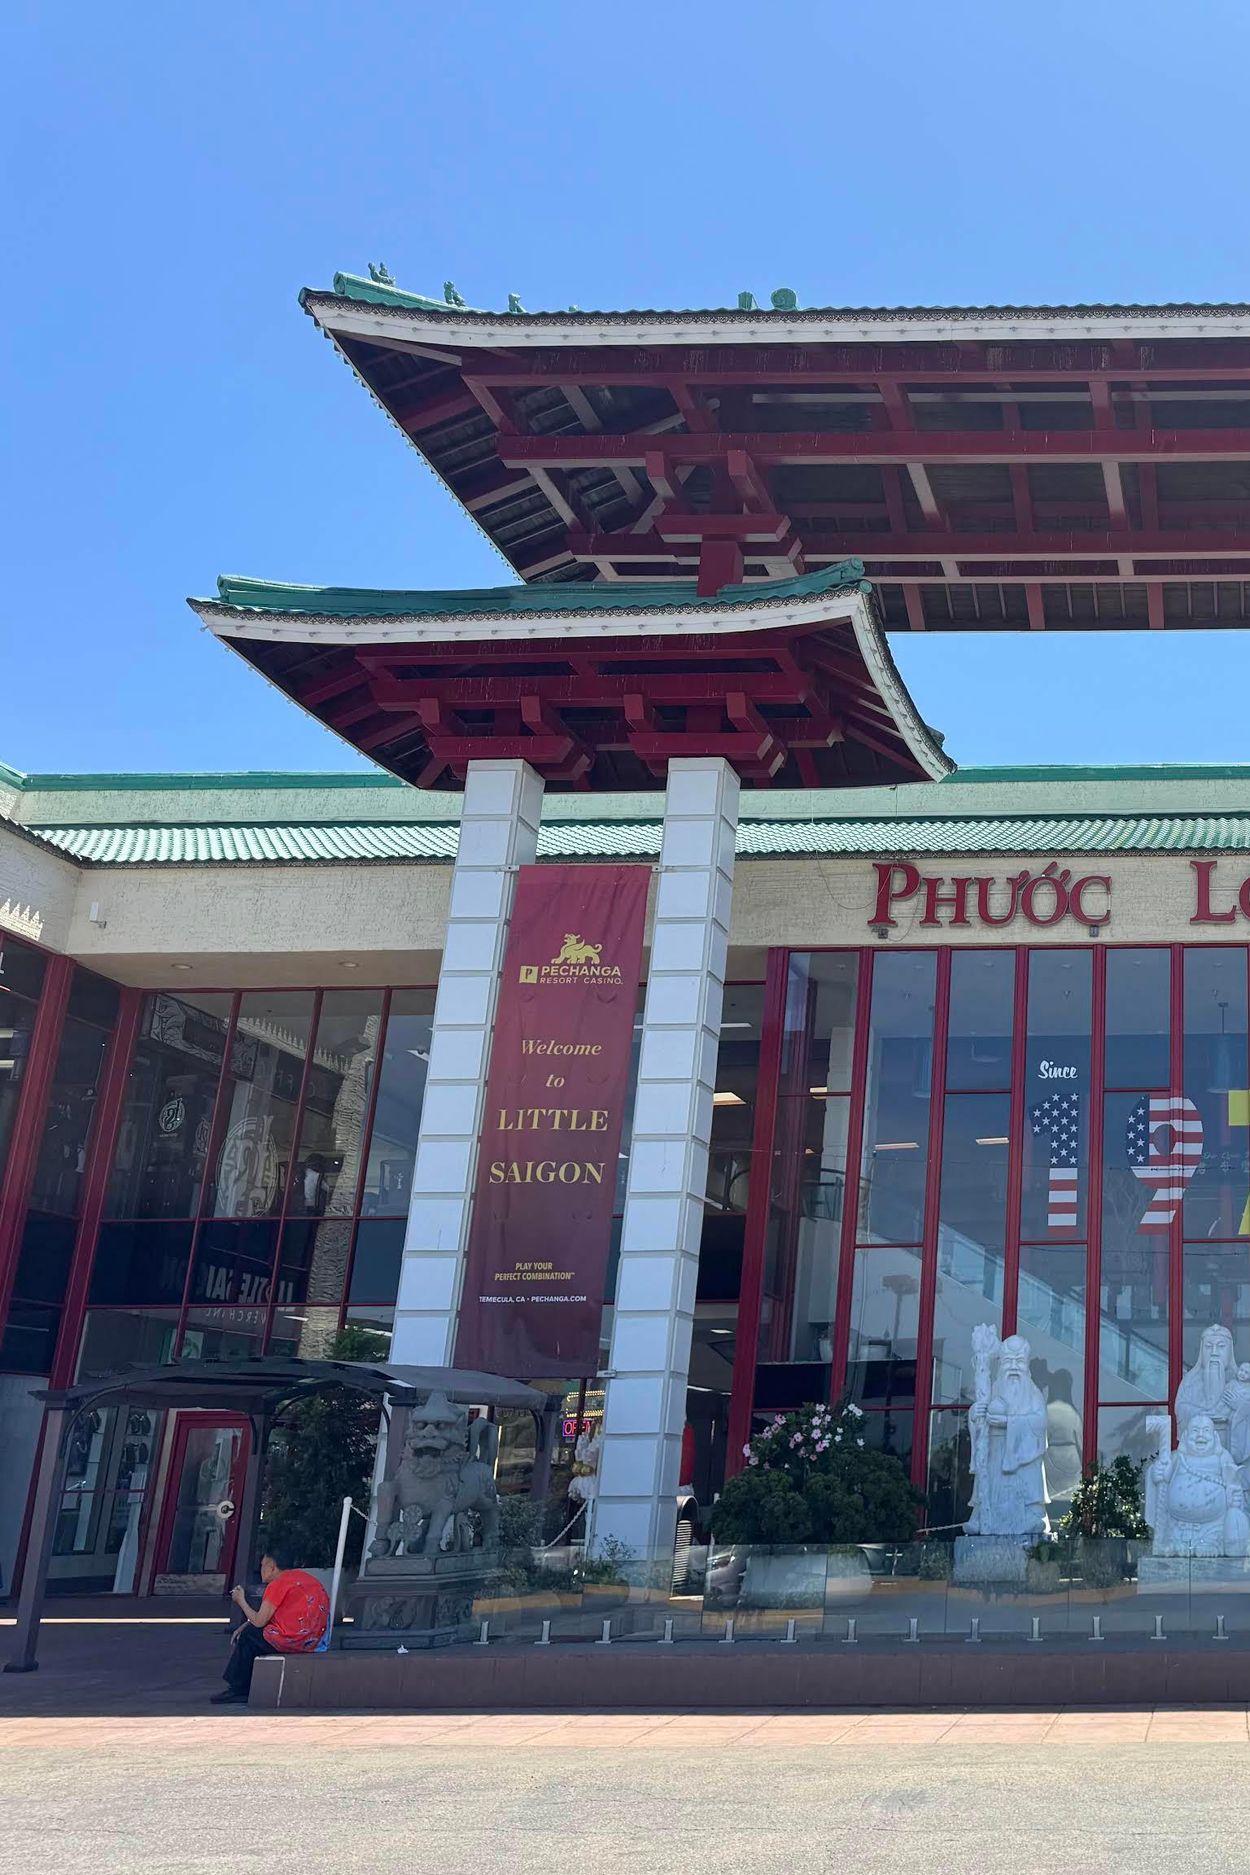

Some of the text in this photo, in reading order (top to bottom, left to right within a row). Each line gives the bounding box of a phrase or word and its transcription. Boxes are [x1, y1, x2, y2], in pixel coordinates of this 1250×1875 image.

[541, 965, 621, 977] PECHANGA
[521, 1039, 602, 1056] Welcome
[1038, 1060, 1078, 1080] Since
[545, 1074, 565, 1088] to
[496, 1108, 609, 1131] LITTLE
[489, 1160, 606, 1184] SAIGON
[515, 1262, 552, 1270] PLAY YOUR
[495, 1272, 521, 1280] PERFECT
